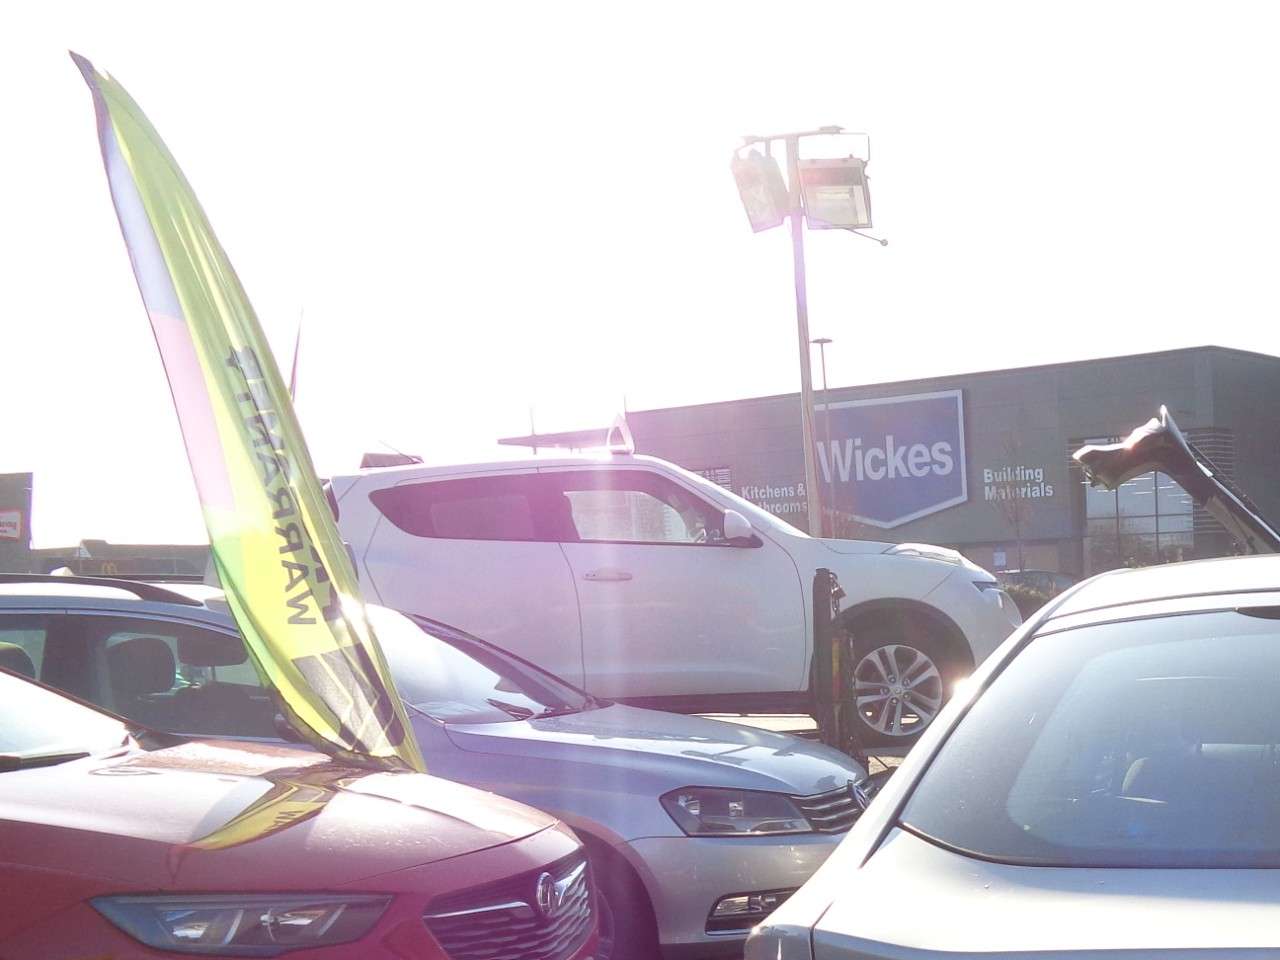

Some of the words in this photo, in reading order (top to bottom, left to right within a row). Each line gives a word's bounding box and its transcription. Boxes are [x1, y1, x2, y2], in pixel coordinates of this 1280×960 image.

[816, 435, 954, 484] Wickes
[983, 465, 1044, 483] Building
[741, 484, 795, 500] Kitchens
[797, 483, 806, 497] &
